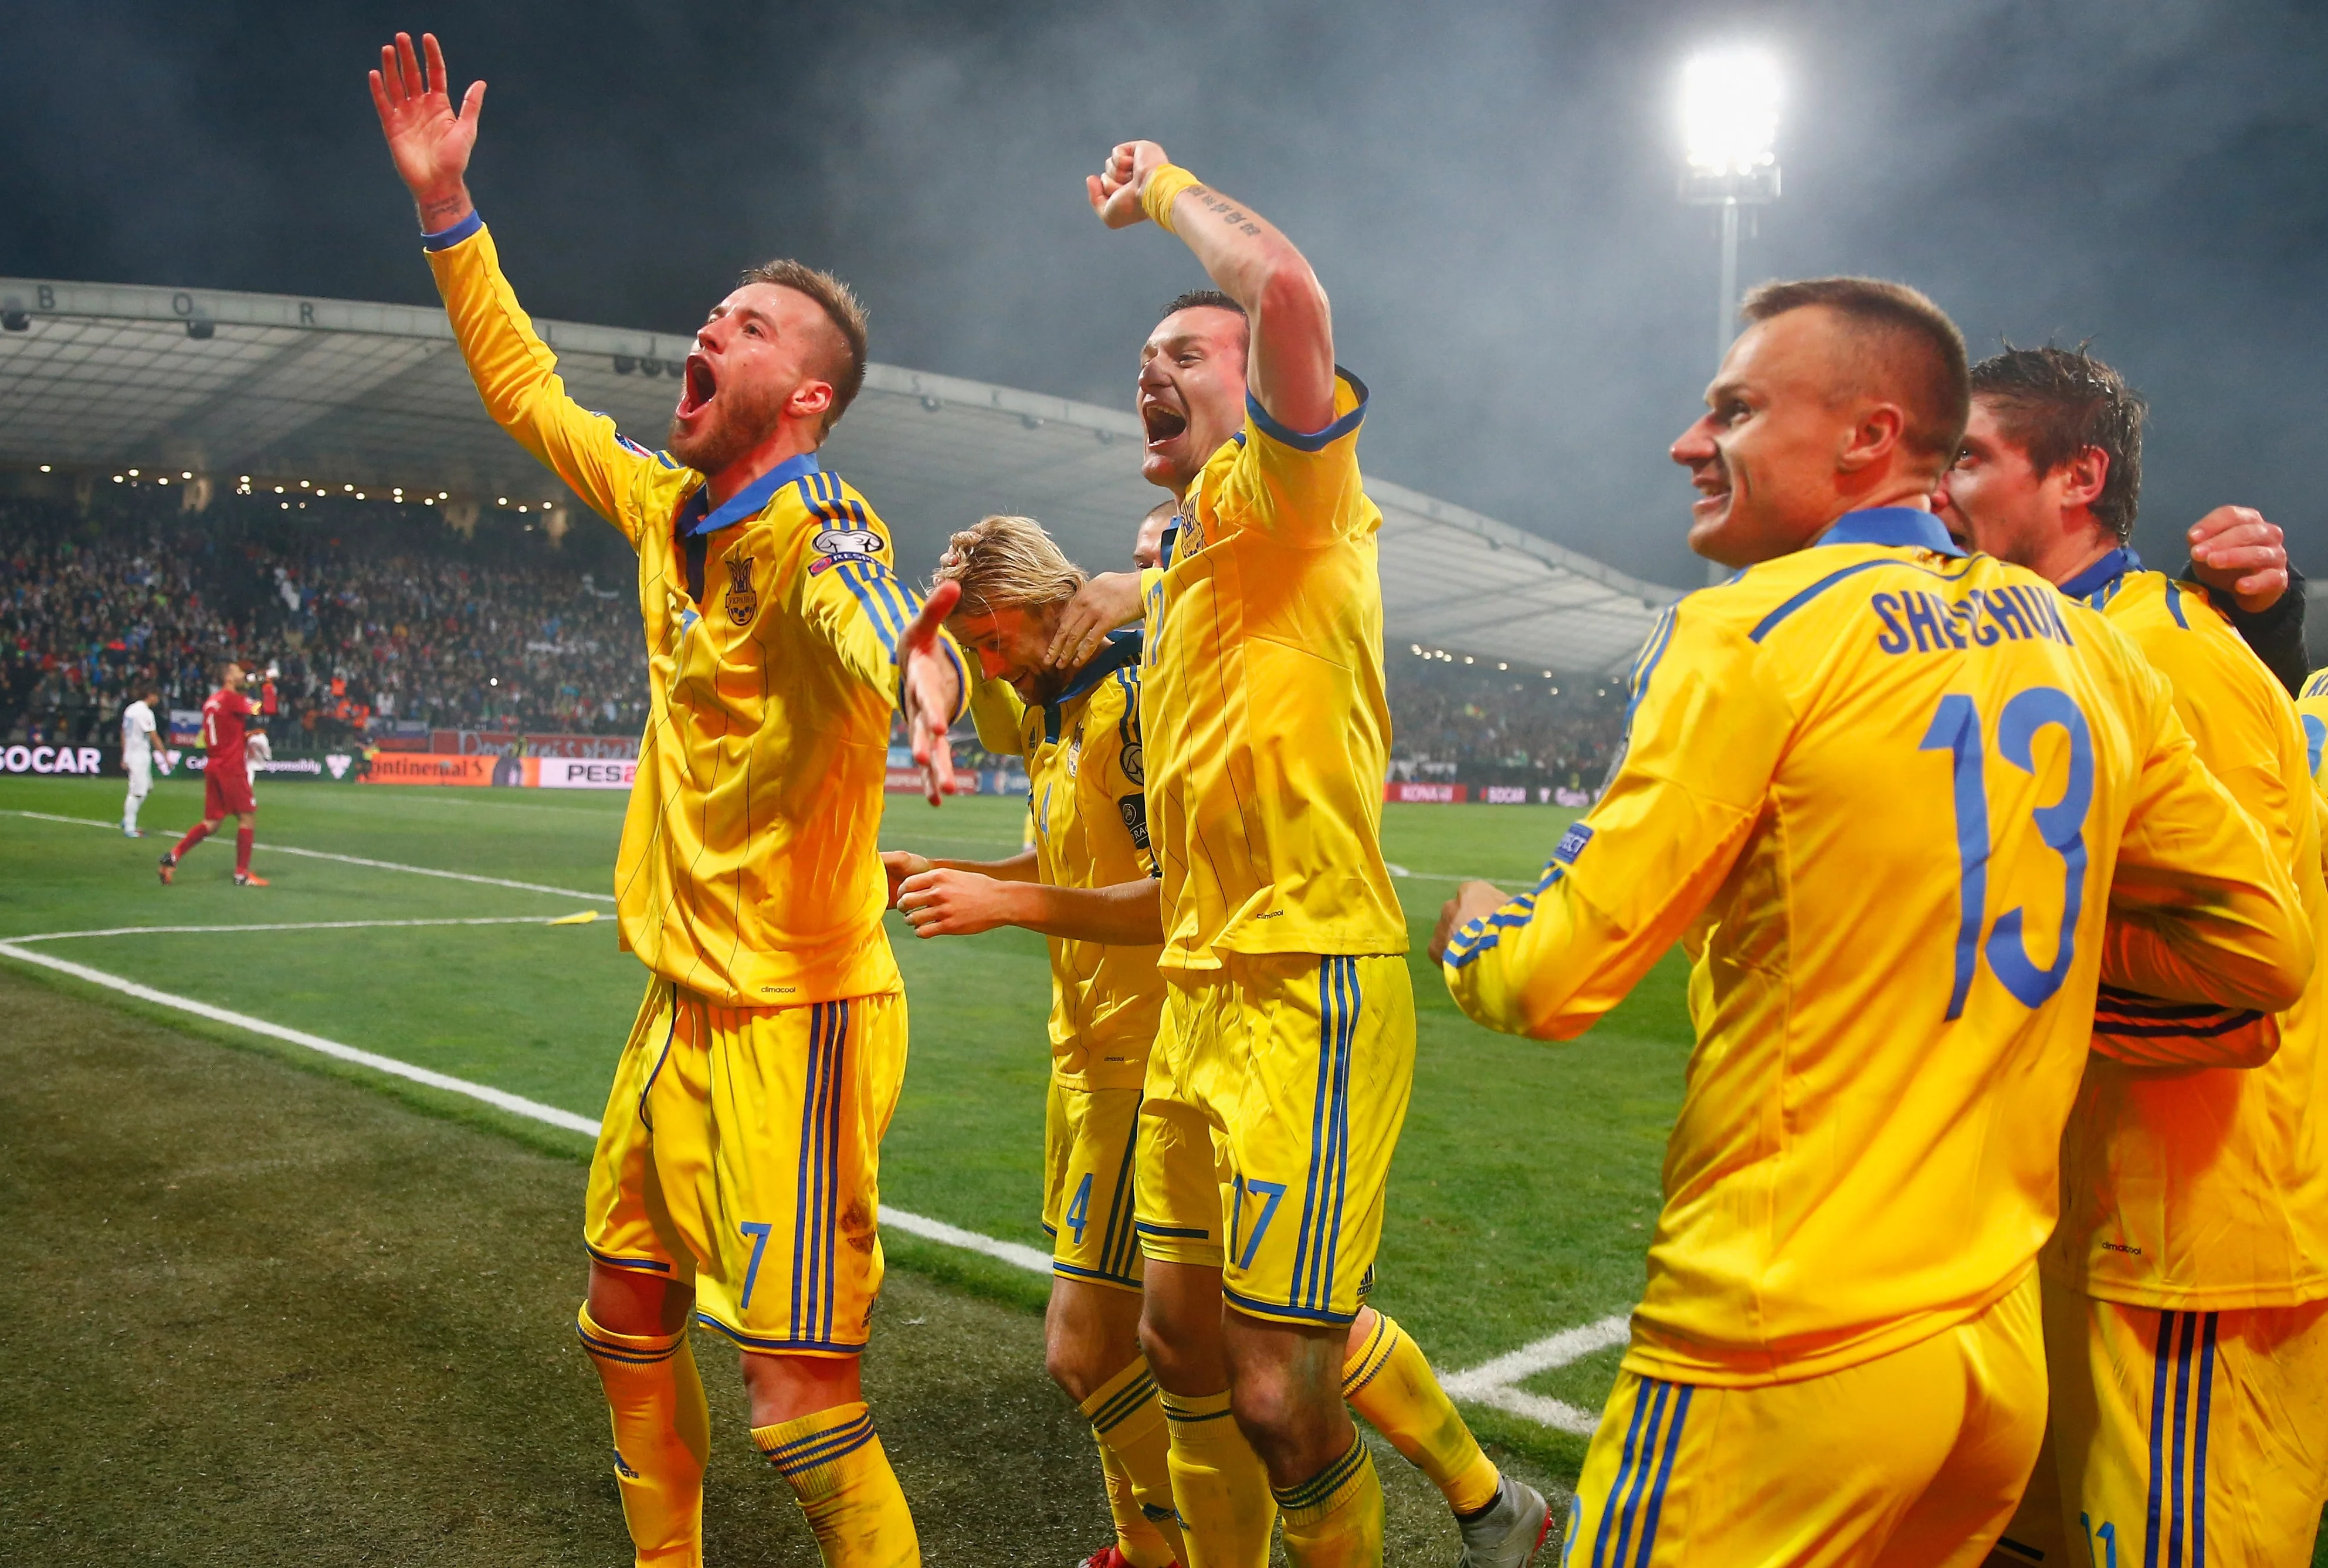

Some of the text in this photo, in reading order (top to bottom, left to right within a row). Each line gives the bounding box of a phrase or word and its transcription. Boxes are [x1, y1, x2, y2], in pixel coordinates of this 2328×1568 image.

[207, 713, 218, 746] 1
[367, 756, 467, 778] ontinental
[1919, 686, 2094, 1022] 13
[1065, 1173, 1093, 1244] 4
[1230, 1174, 1287, 1271] 17
[740, 1221, 772, 1310] 7
